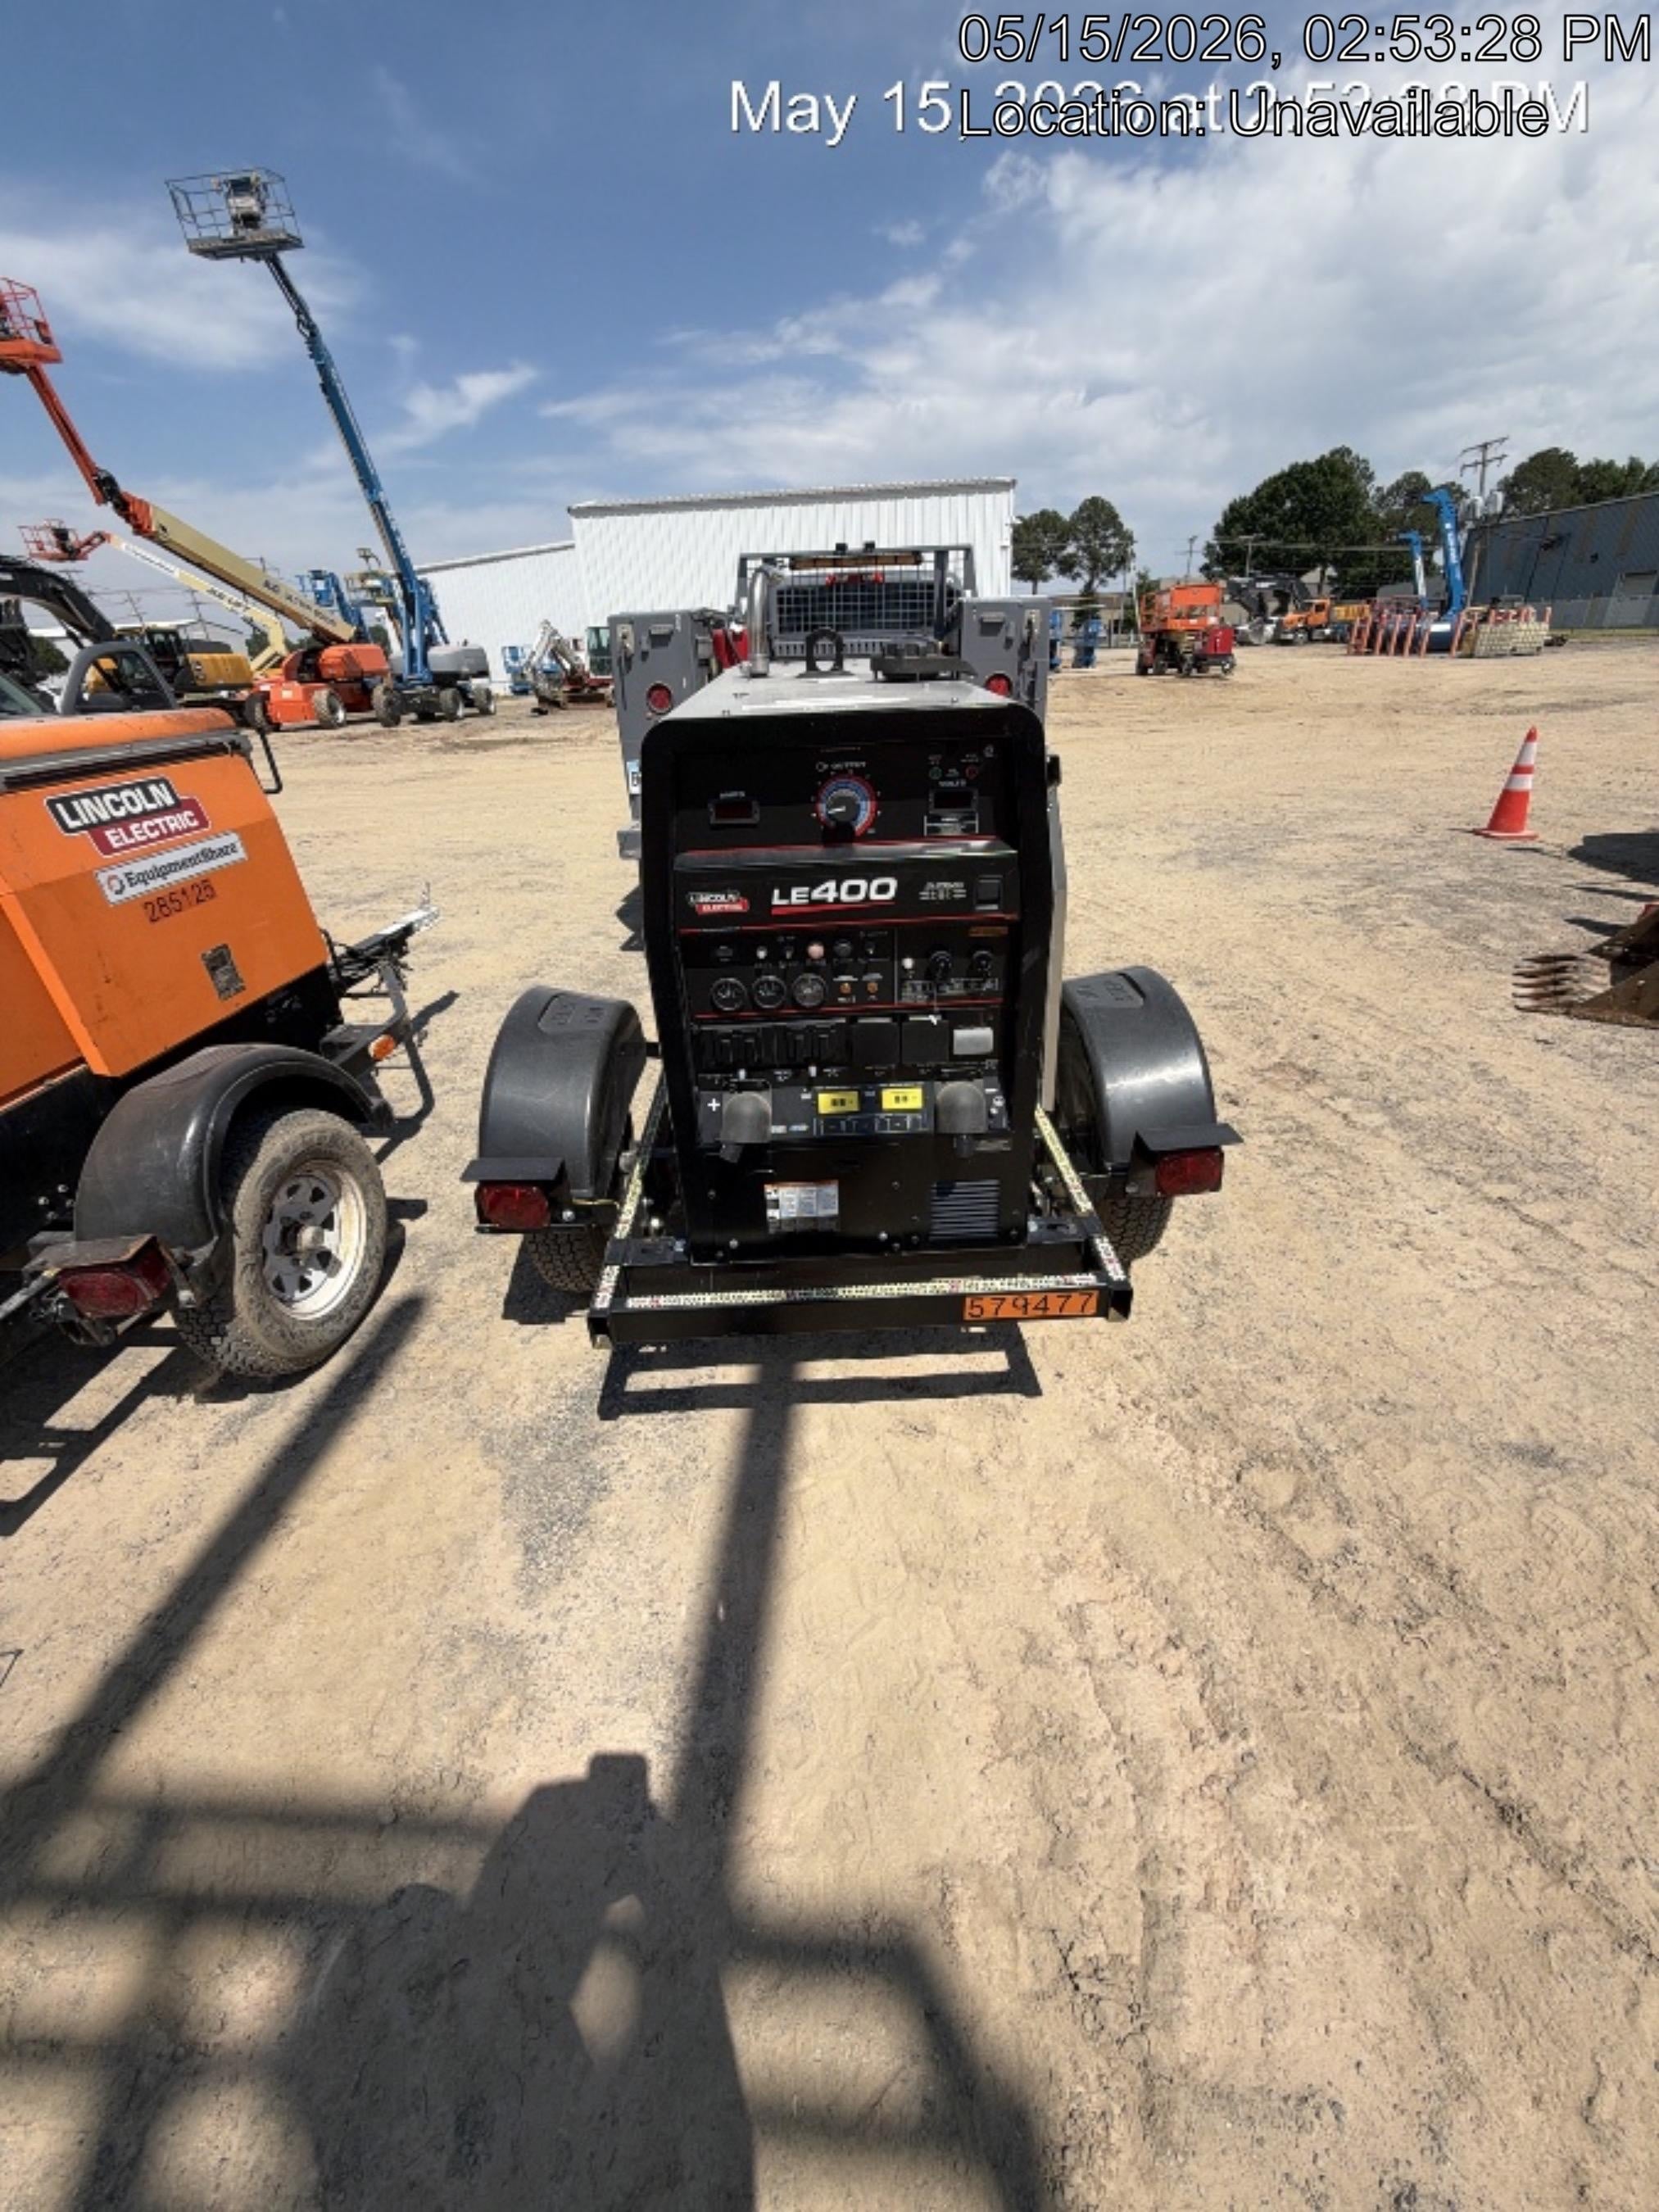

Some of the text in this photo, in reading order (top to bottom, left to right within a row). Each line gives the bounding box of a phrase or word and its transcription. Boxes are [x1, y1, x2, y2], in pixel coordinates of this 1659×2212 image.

[56, 782, 175, 829] LINCOLN
[104, 809, 200, 849] ELECTRIC
[125, 841, 239, 885] EquipmentShare
[771, 877, 898, 905] LE400
[968, 1291, 1095, 1318] 579477
